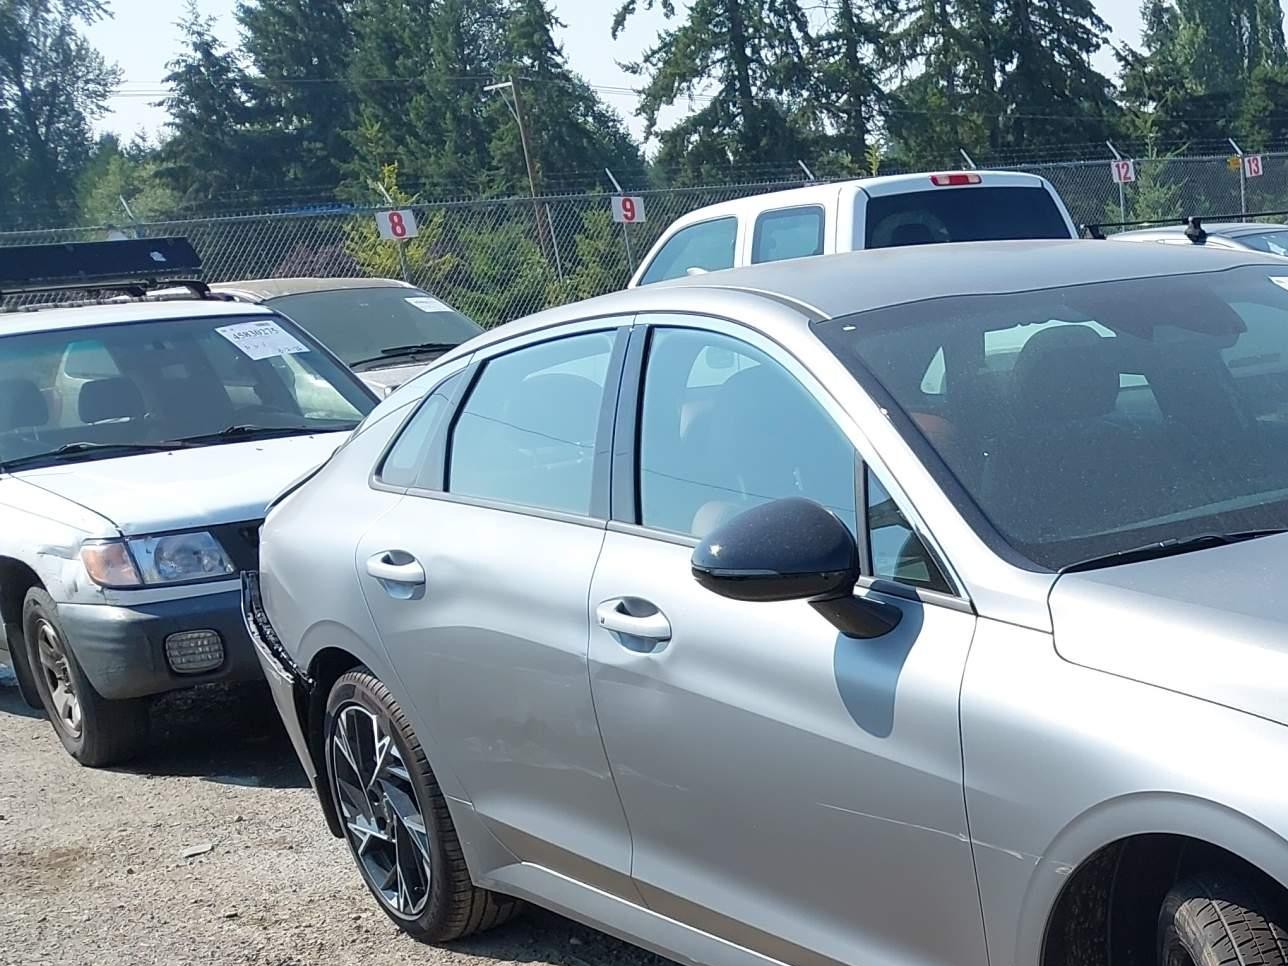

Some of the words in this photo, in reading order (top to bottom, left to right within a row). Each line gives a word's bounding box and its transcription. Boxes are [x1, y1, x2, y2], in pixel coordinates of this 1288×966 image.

[1115, 162, 1131, 181] 12
[1247, 157, 1260, 175] 13
[621, 197, 635, 221] 9
[388, 211, 406, 238] 8
